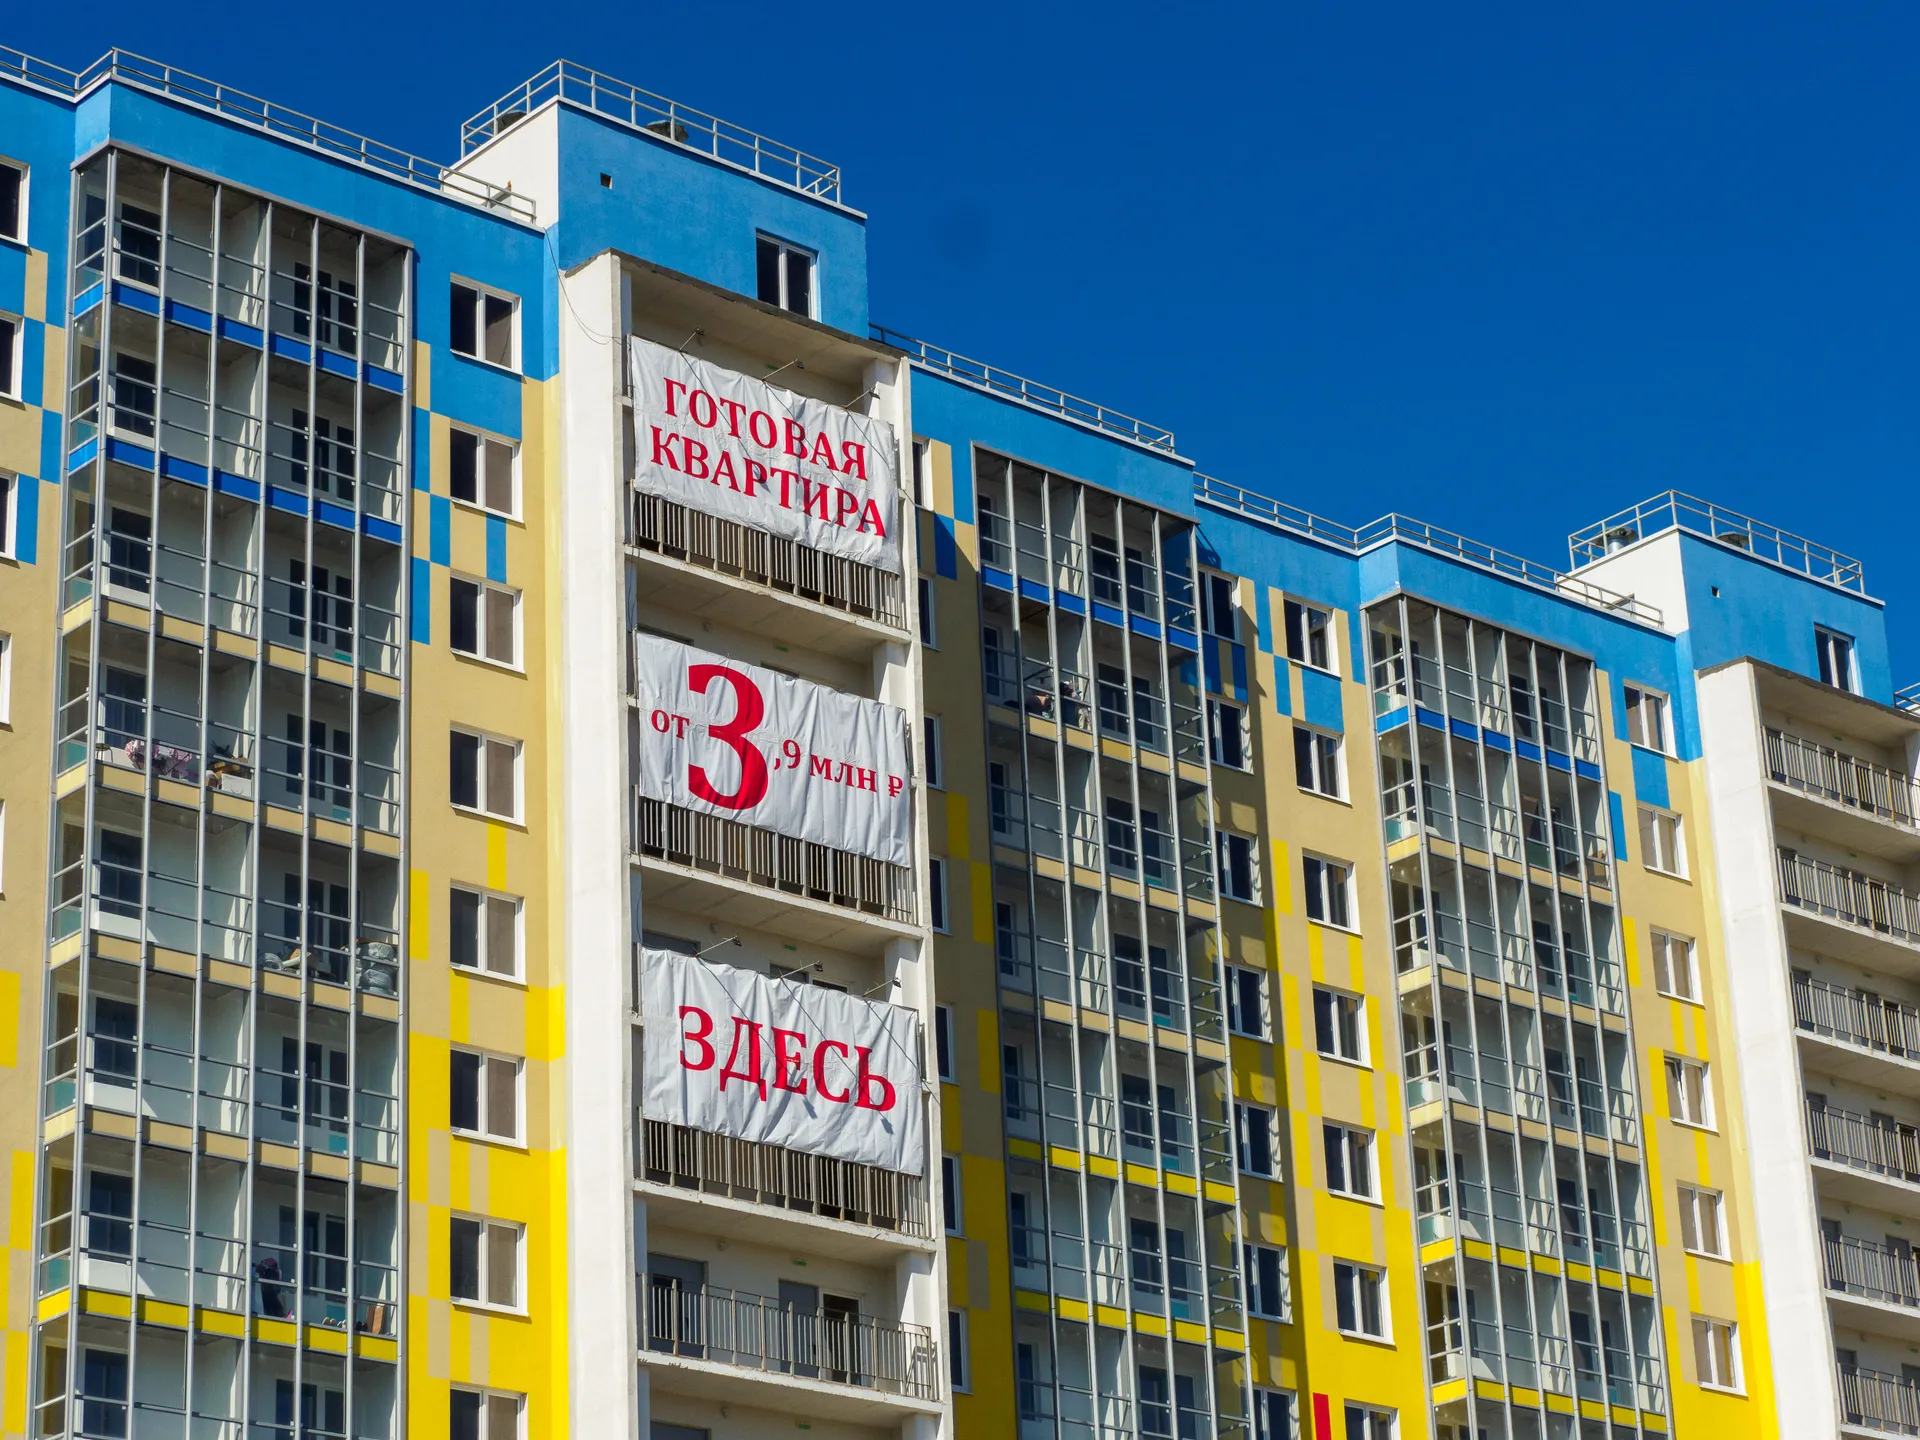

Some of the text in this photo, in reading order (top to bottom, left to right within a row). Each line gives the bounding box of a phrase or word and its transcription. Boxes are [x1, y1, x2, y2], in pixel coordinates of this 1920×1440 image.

[649, 425, 886, 538] КВАРТИРА
[663, 377, 868, 481] ГОТОВАЯ
[677, 1005, 897, 1113] ЗДЕСЬ
